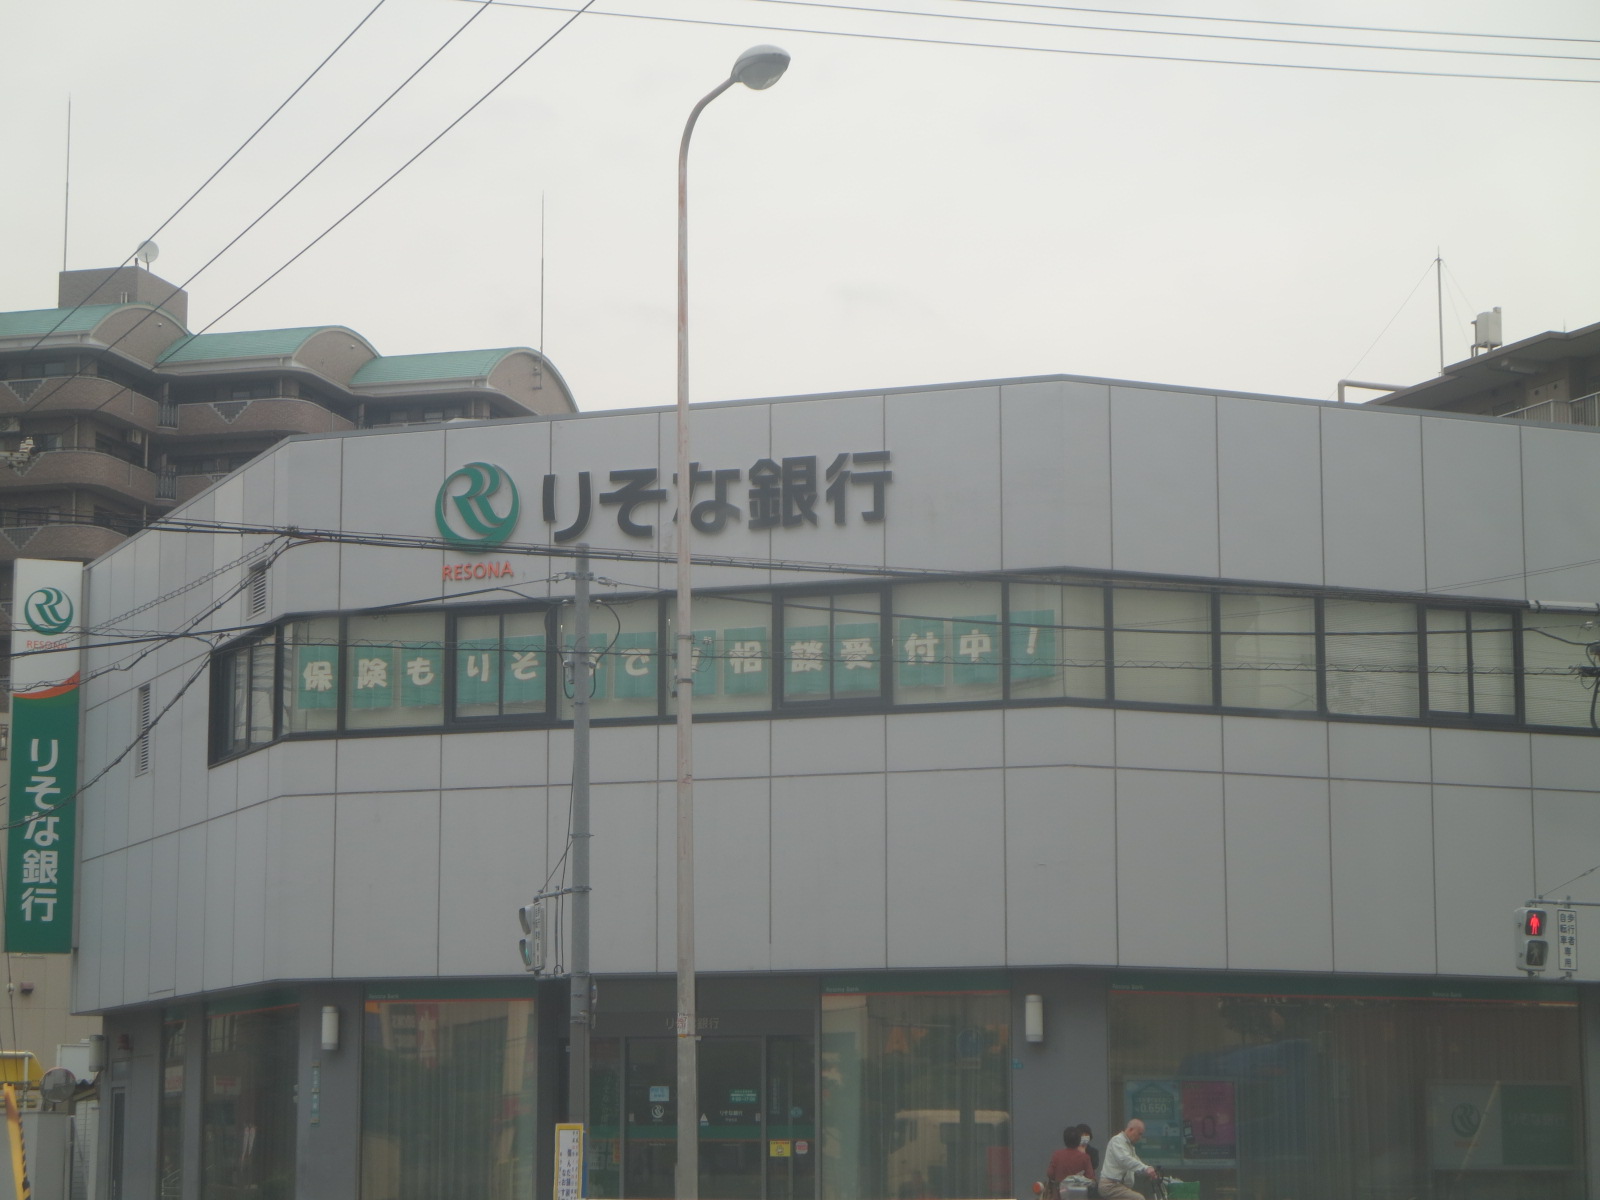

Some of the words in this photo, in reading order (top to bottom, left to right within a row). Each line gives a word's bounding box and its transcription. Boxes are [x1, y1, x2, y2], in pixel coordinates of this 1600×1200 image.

[542, 450, 893, 543] りそな銀行
[442, 561, 514, 581] RESONA
[303, 627, 1039, 691] 保険もりそで相談受付中!
[21, 738, 61, 922] りそな銀行
[665, 1016, 720, 1030] り銀行
